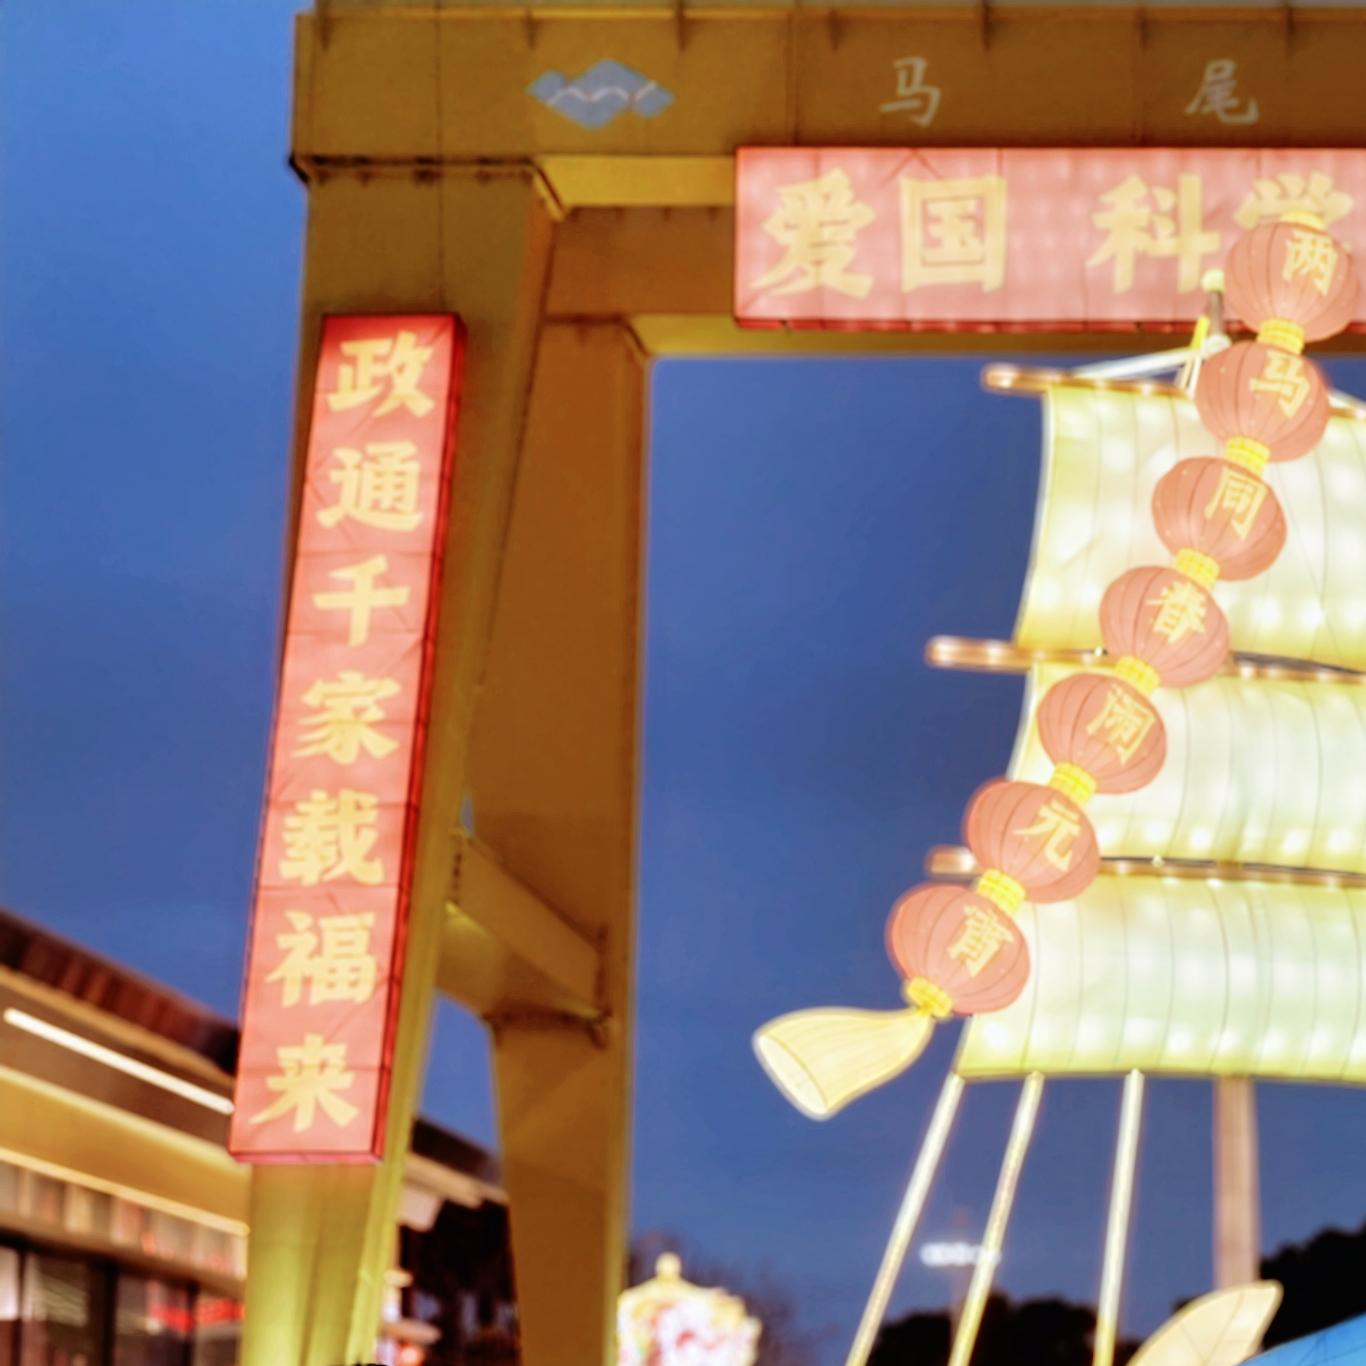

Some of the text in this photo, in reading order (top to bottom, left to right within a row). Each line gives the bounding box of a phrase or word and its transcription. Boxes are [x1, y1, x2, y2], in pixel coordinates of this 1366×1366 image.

[751, 167, 1007, 299] 爱国
[949, 230, 1339, 978] 两马同春闹元宵
[250, 331, 437, 1133] 政通千家载福来
